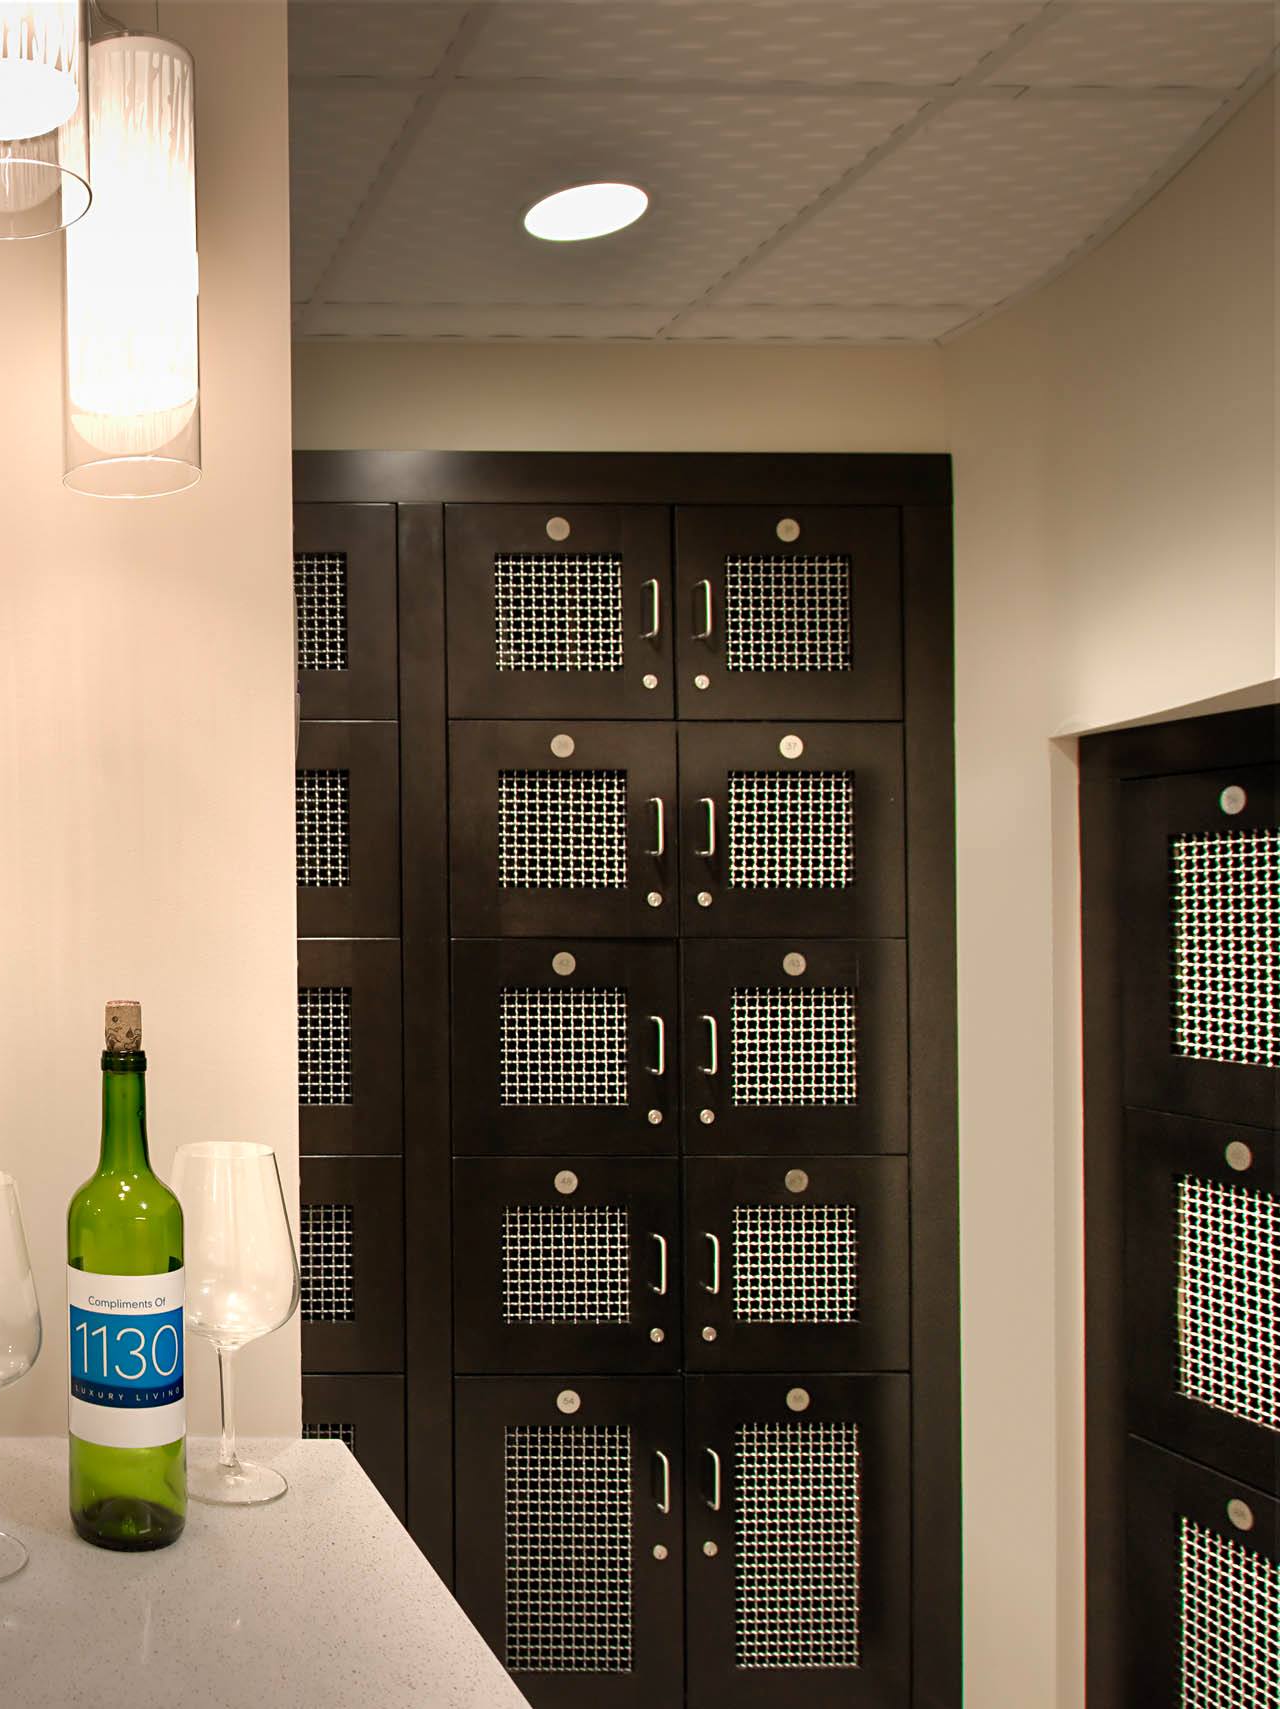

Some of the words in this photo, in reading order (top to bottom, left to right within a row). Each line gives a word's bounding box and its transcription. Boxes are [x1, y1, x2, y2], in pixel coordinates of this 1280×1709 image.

[88, 1295, 152, 1310] Compliments
[154, 1296, 166, 1307] Of
[75, 1321, 179, 1380] 1130
[75, 1384, 124, 1401] LUXURY
